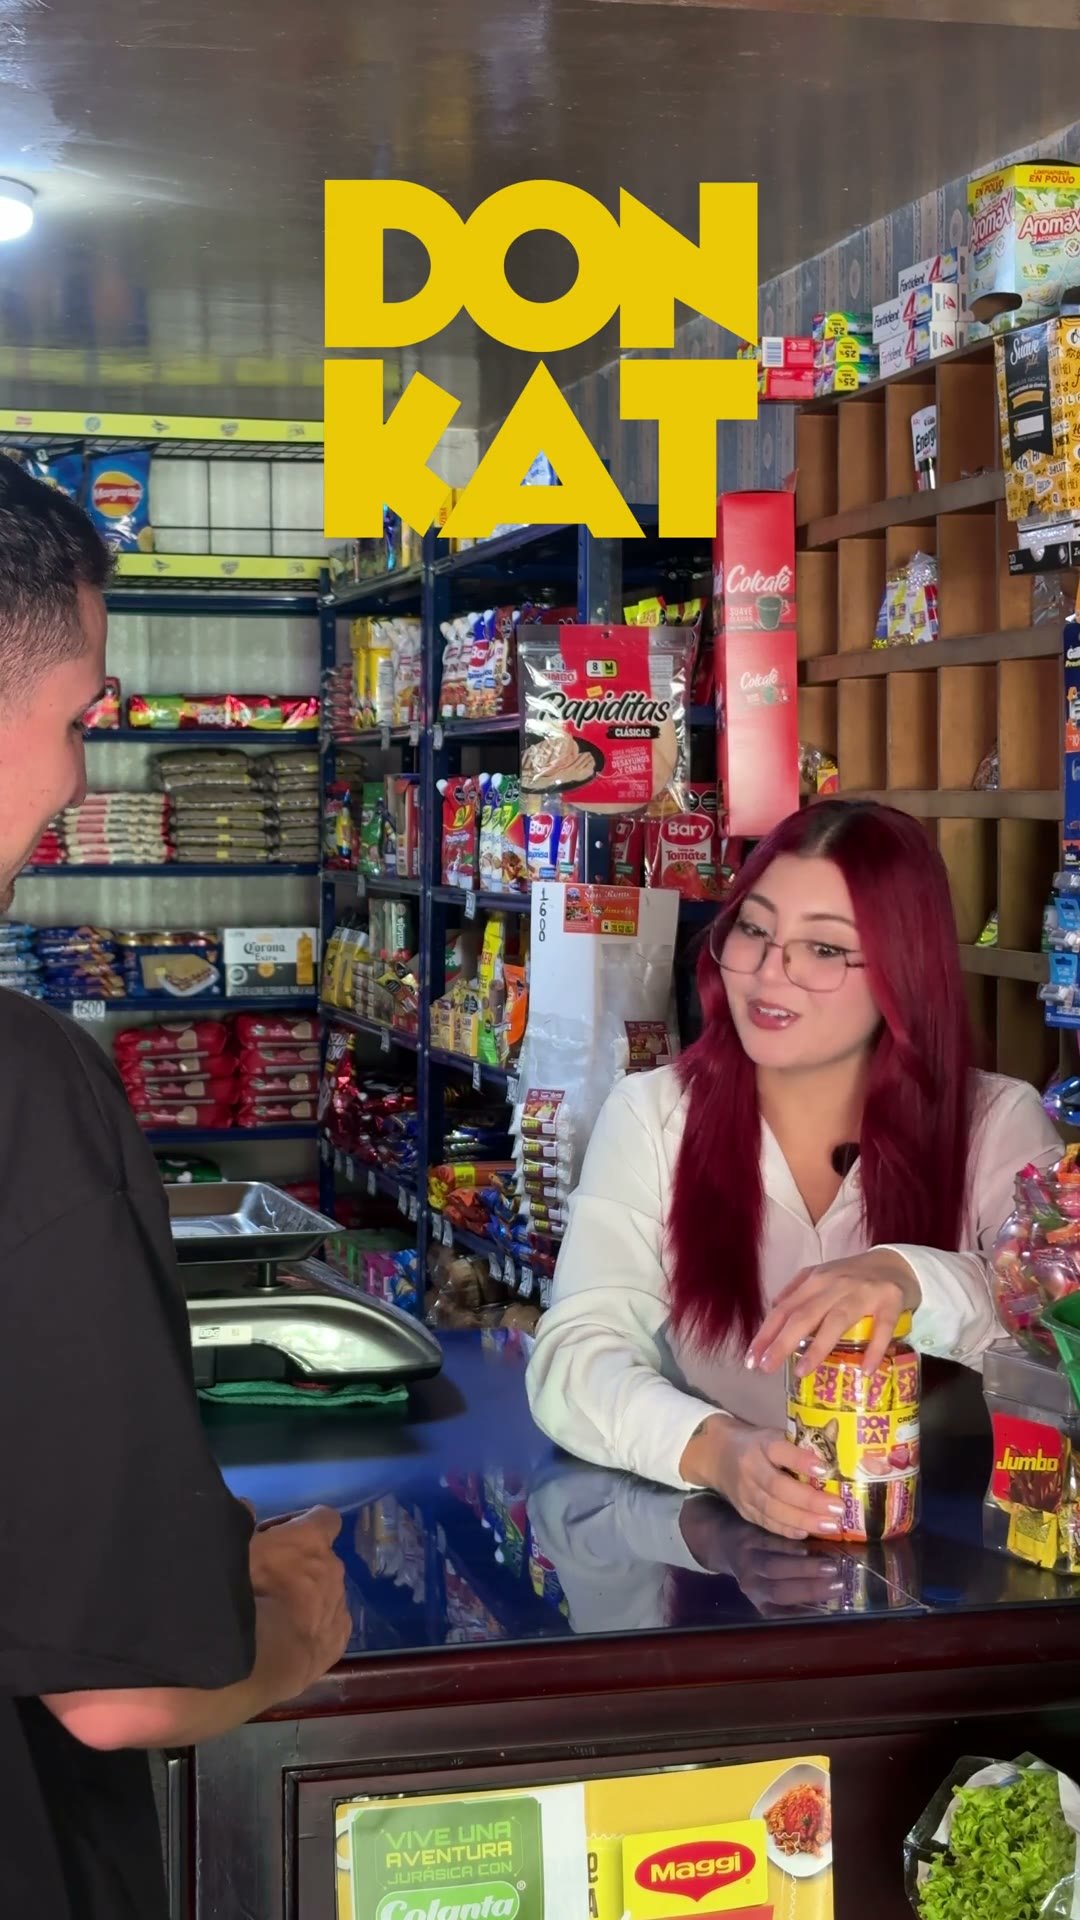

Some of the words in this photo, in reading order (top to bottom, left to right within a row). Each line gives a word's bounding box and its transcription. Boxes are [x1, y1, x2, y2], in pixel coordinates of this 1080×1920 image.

[1029, 175, 1042, 183] EN
[1044, 175, 1076, 184] POLVO
[903, 291, 917, 330] 4
[1010, 337, 1041, 366] Suave
[538, 691, 671, 730] Rapiditas
[614, 726, 651, 738] CLÁSICAS
[611, 757, 650, 769] DESAYUNOS
[667, 821, 710, 840] Bary
[665, 850, 707, 861] Tomate
[243, 942, 287, 955] Corona
[254, 952, 278, 962] Extra
[857, 1415, 890, 1430] DON
[856, 1428, 890, 1444] KAT
[995, 1447, 1059, 1472] Jumbo
[385, 1826, 450, 1850] VIVE
[458, 1821, 512, 1844] UNA
[386, 1840, 513, 1869] AVENTURA
[387, 1865, 473, 1885] JURÁSICA
[478, 1860, 513, 1876] CON
[650, 1851, 742, 1884] Maggi
[379, 1894, 515, 1920] Colanta
